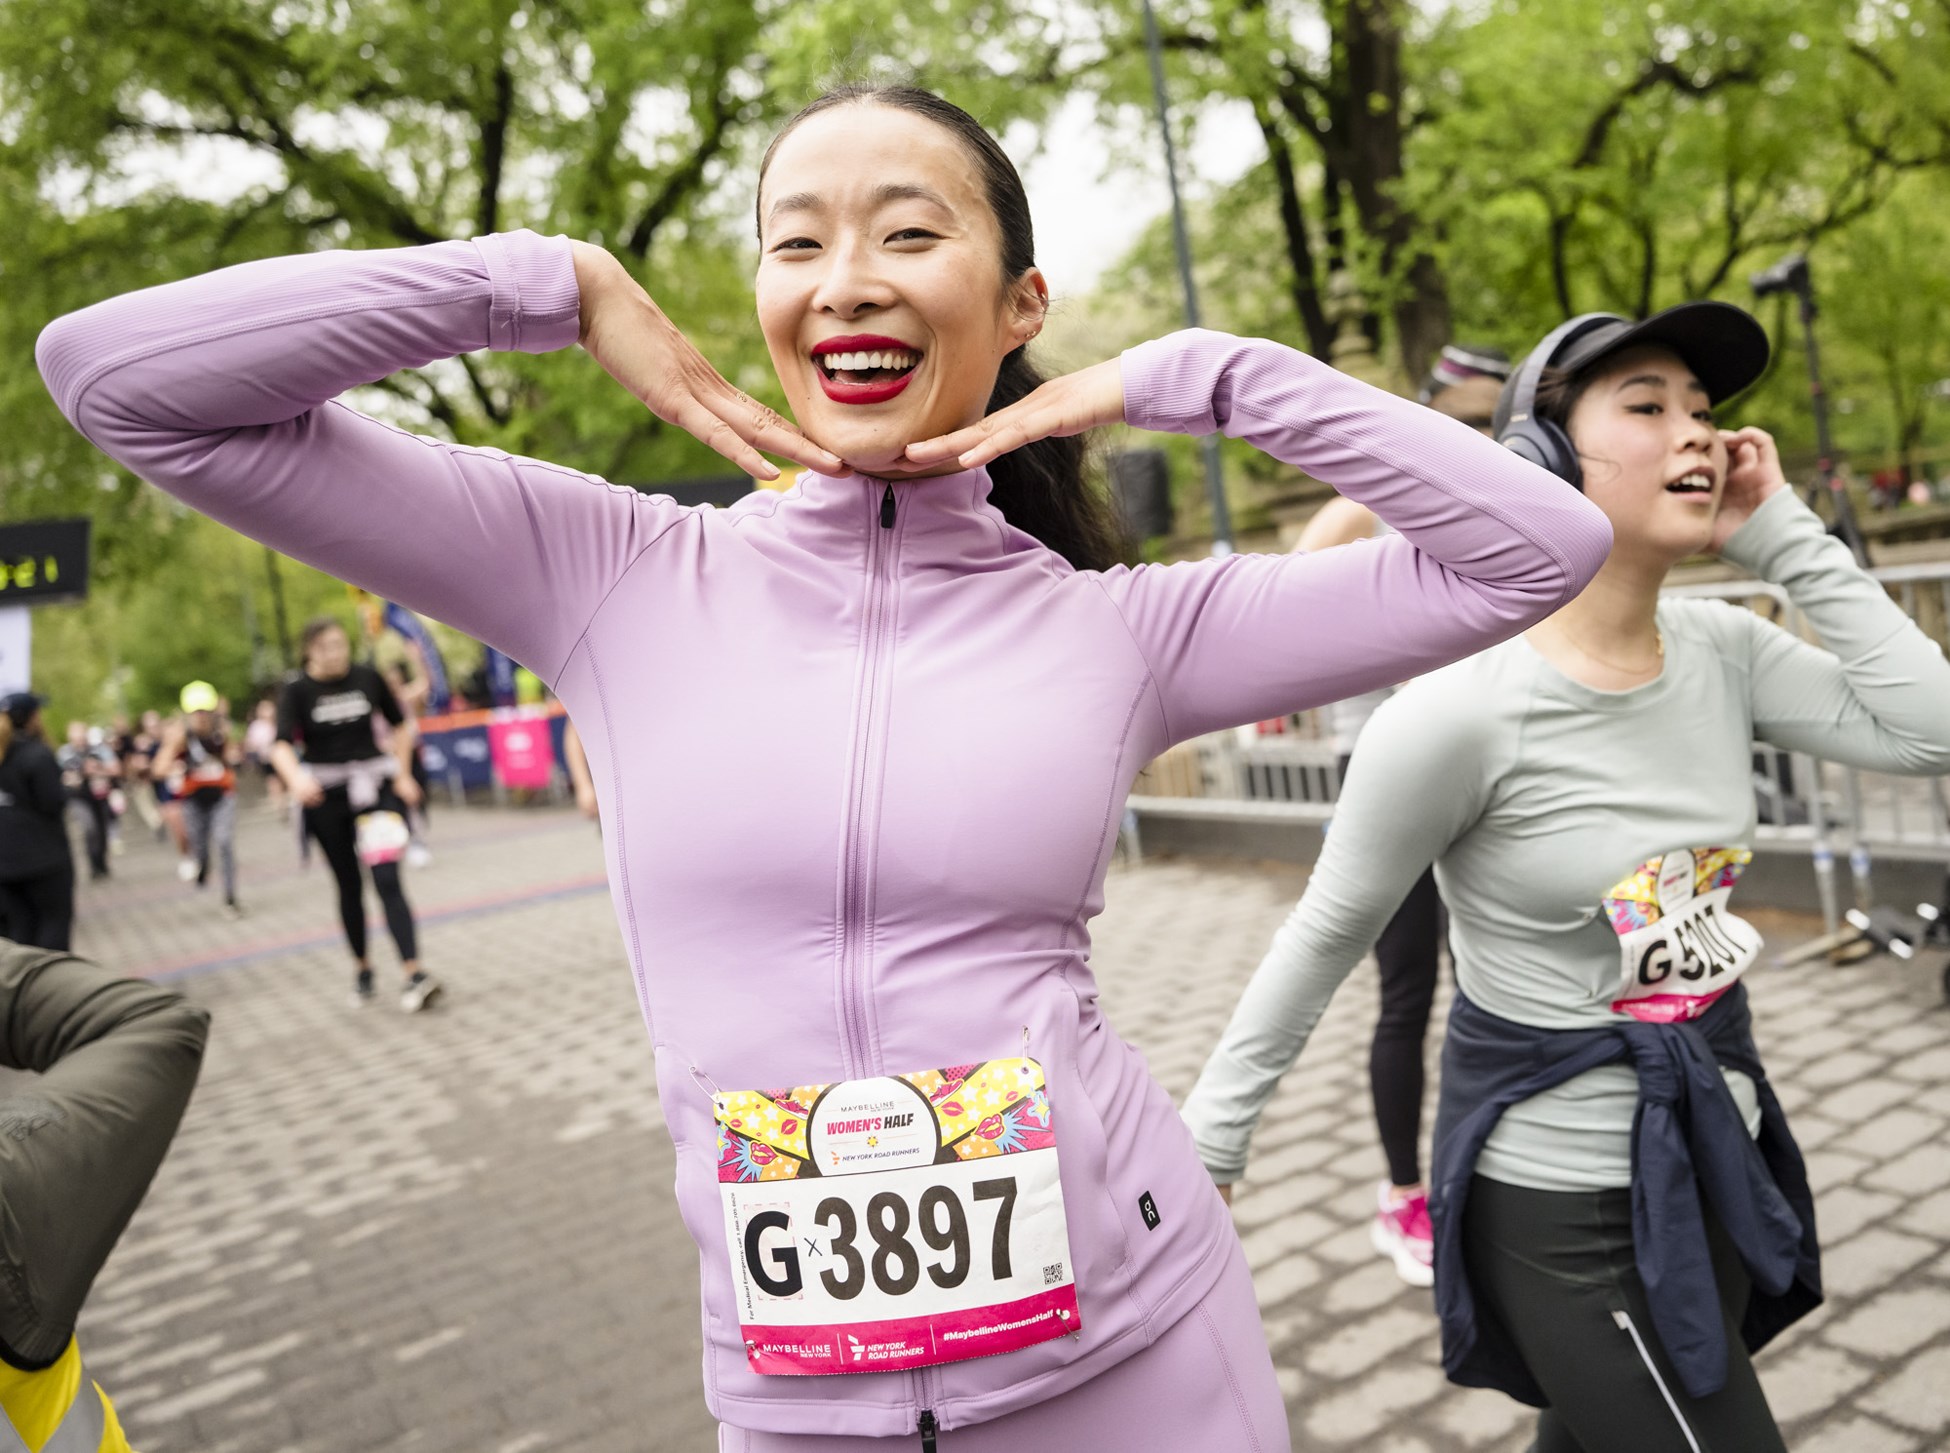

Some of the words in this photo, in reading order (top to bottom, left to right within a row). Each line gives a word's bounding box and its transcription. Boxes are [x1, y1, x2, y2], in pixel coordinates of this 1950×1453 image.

[1639, 939, 1673, 986] G
[840, 1101, 895, 1113] MAYBELLINE
[827, 1117, 882, 1136] WOMEN'S
[883, 1113, 914, 1130] HALF
[842, 1154, 857, 1162] NEW
[857, 1152, 873, 1161] YORK
[874, 1151, 891, 1159] ROAD
[891, 1147, 920, 1157] RUNNERS
[744, 1211, 803, 1297] G
[814, 1176, 1018, 1301] 3897
[744, 1285, 752, 1309] Medical
[943, 1309, 1054, 1341] #MaybellineWomensHalf
[762, 1344, 831, 1354] MAYBELLINE
[867, 1344, 885, 1352] NEW
[885, 1341, 906, 1351] YORK
[867, 1351, 888, 1360] ROAD
[889, 1346, 924, 1358] RUNNERS
